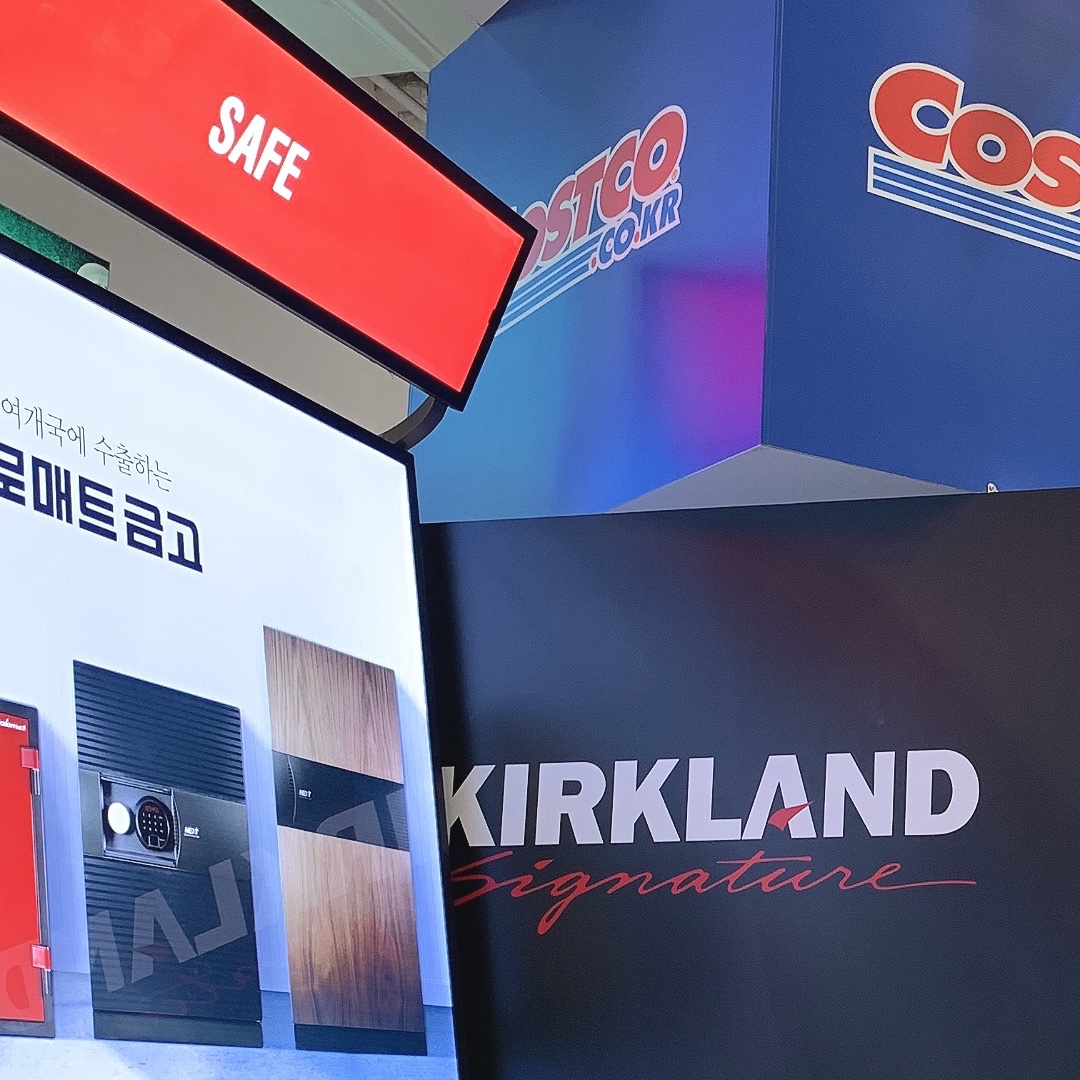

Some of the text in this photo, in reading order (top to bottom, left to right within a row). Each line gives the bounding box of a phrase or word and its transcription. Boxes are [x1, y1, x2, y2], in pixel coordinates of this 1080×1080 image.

[208, 95, 310, 201] SAFE
[507, 107, 687, 282] OSTCO
[589, 183, 682, 270] .CO.KR
[1, 397, 172, 493] 여개국에 수출하는
[441, 748, 980, 848] KIRKLAND
[450, 850, 977, 935] Signature
